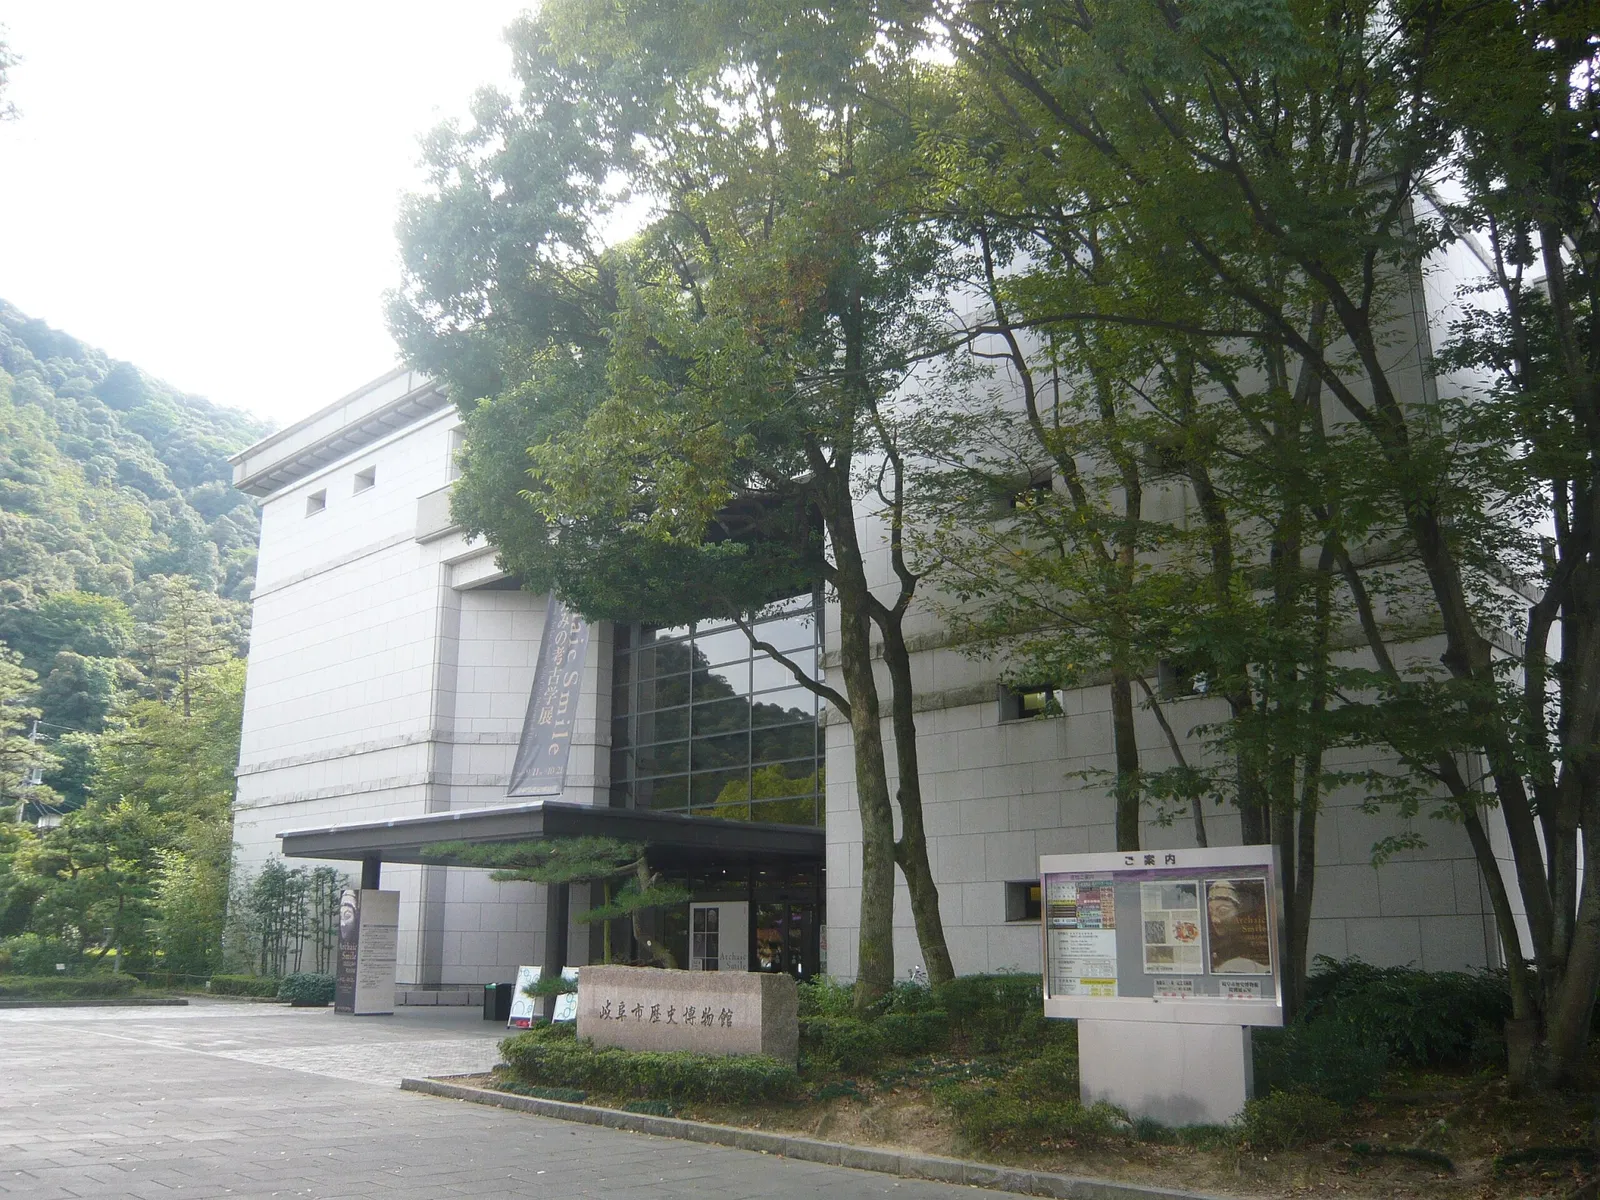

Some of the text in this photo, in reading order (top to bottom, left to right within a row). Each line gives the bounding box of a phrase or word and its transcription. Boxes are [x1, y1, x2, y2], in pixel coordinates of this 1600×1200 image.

[547, 670, 579, 756] Smile
[1124, 854, 1176, 866] ご案内
[1241, 925, 1267, 934] Smile
[719, 952, 747, 961] Archaic
[726, 961, 747, 970] Smile
[598, 999, 735, 1028] 岐阜市歴史博物館
